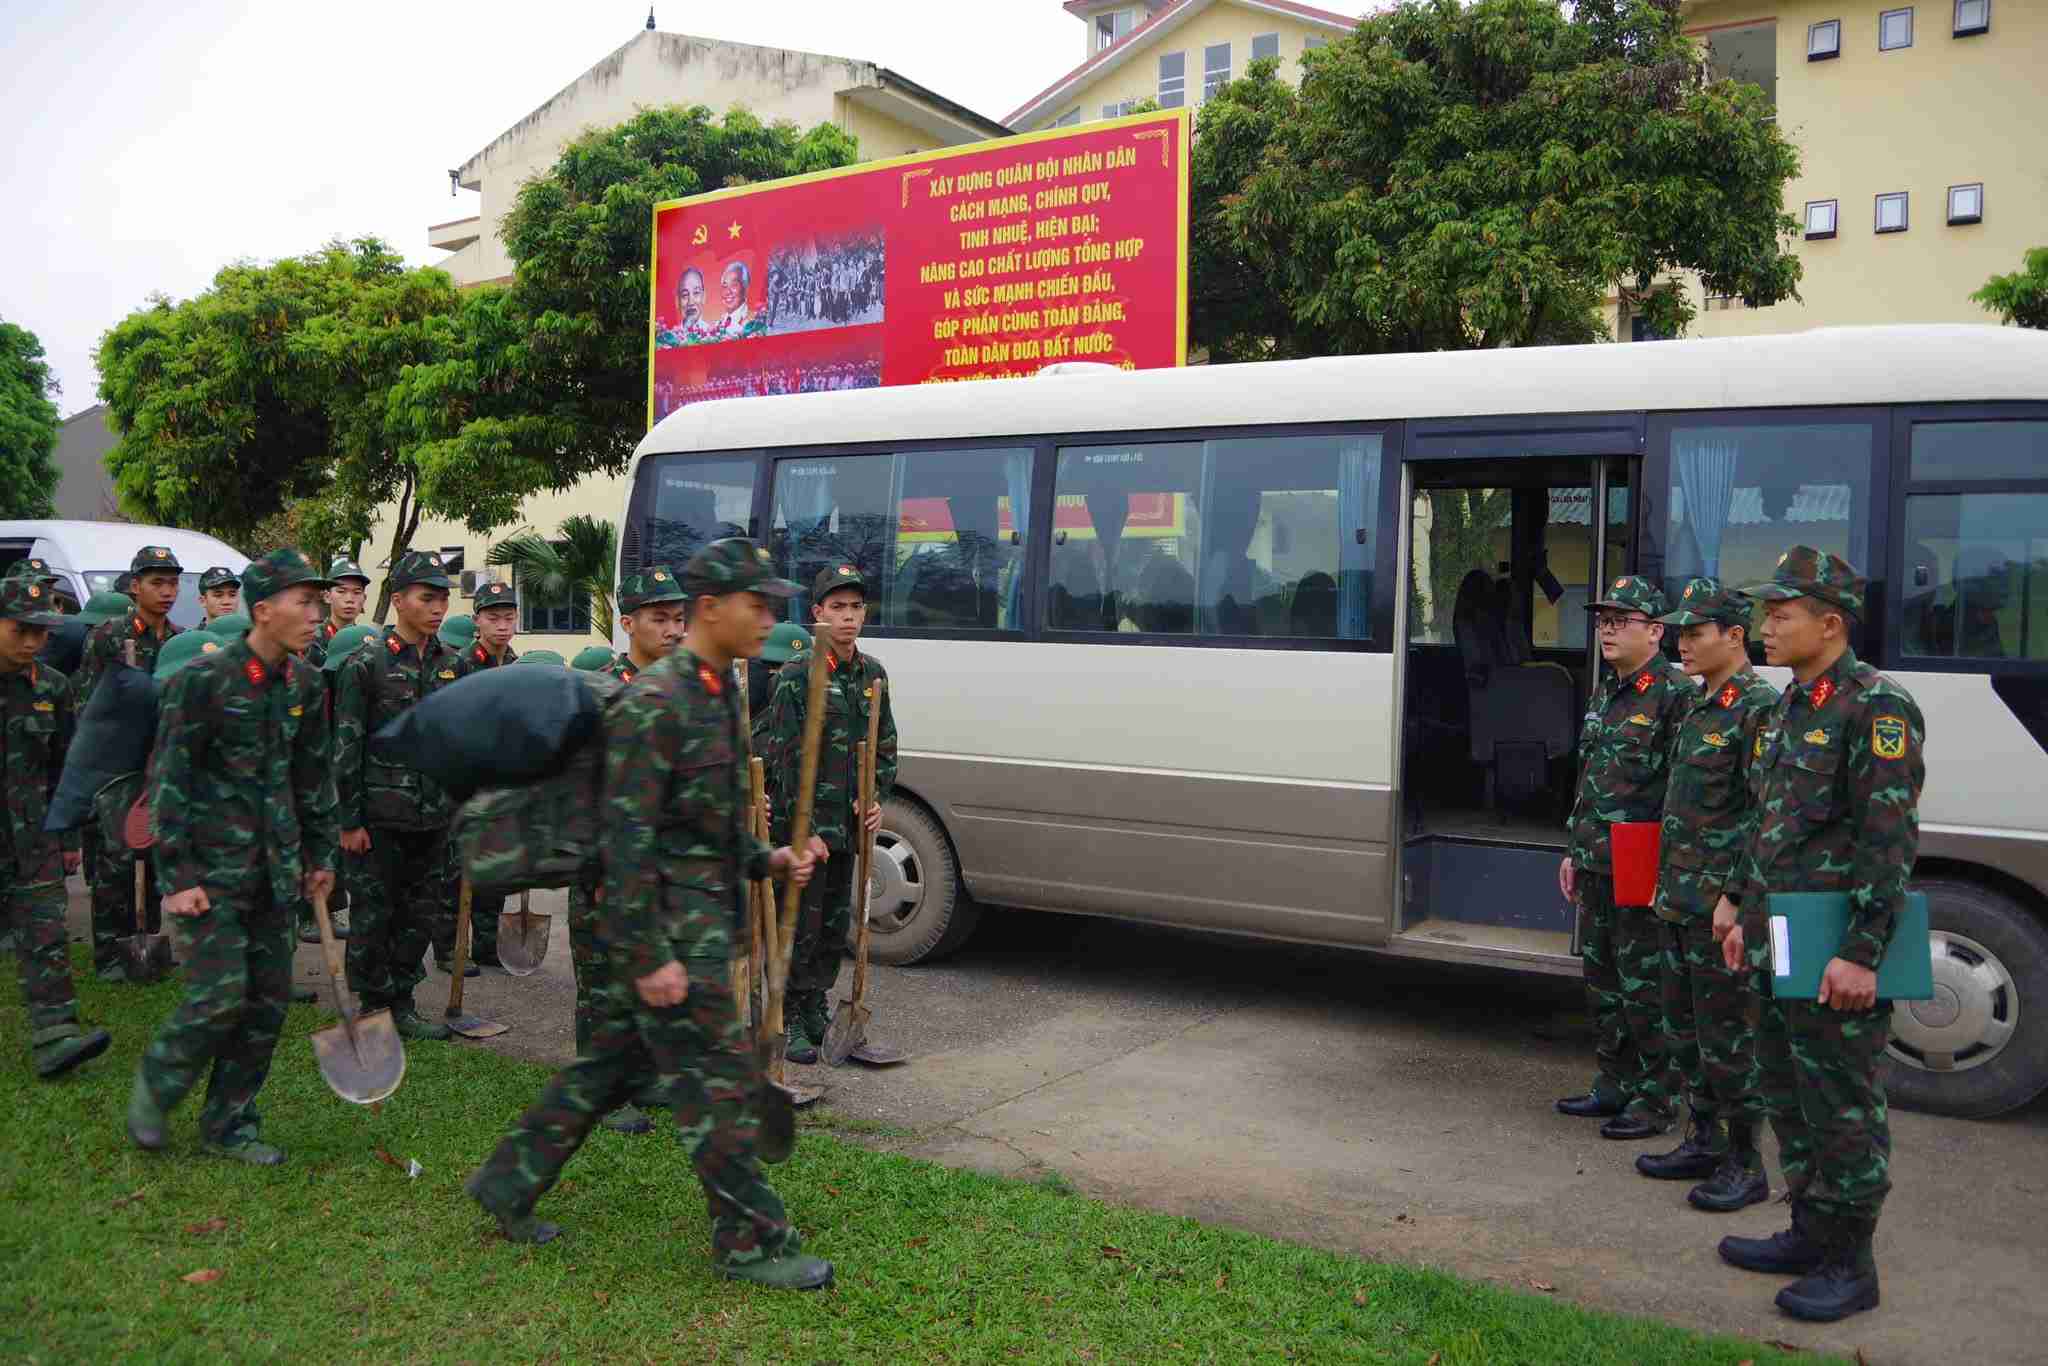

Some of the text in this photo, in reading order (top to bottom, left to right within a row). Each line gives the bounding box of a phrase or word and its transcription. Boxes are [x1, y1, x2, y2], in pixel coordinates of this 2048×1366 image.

[929, 146, 1136, 198] XÂY DỰNG QUÂN ĐỘI NHÂN DÂN
[950, 182, 1110, 223] CÁCH MẠNG, CHÍNH QUY,
[960, 229, 989, 249] TINH
[1036, 216, 1067, 240] HIỆN
[920, 237, 1144, 283] NÂNG CAO CHẤT LƯỢNG TỔNG HỢP
[943, 286, 960, 309] VÀ
[964, 285, 989, 306] SỨC
[994, 282, 1033, 305] MẠNH
[934, 317, 959, 339] GÓP
[1002, 310, 1040, 331] CÙNG
[1043, 305, 1079, 327] TOÀN
[945, 331, 1112, 366] TOÀN DÂN ĐƯA ĐẤT NƯỚC
